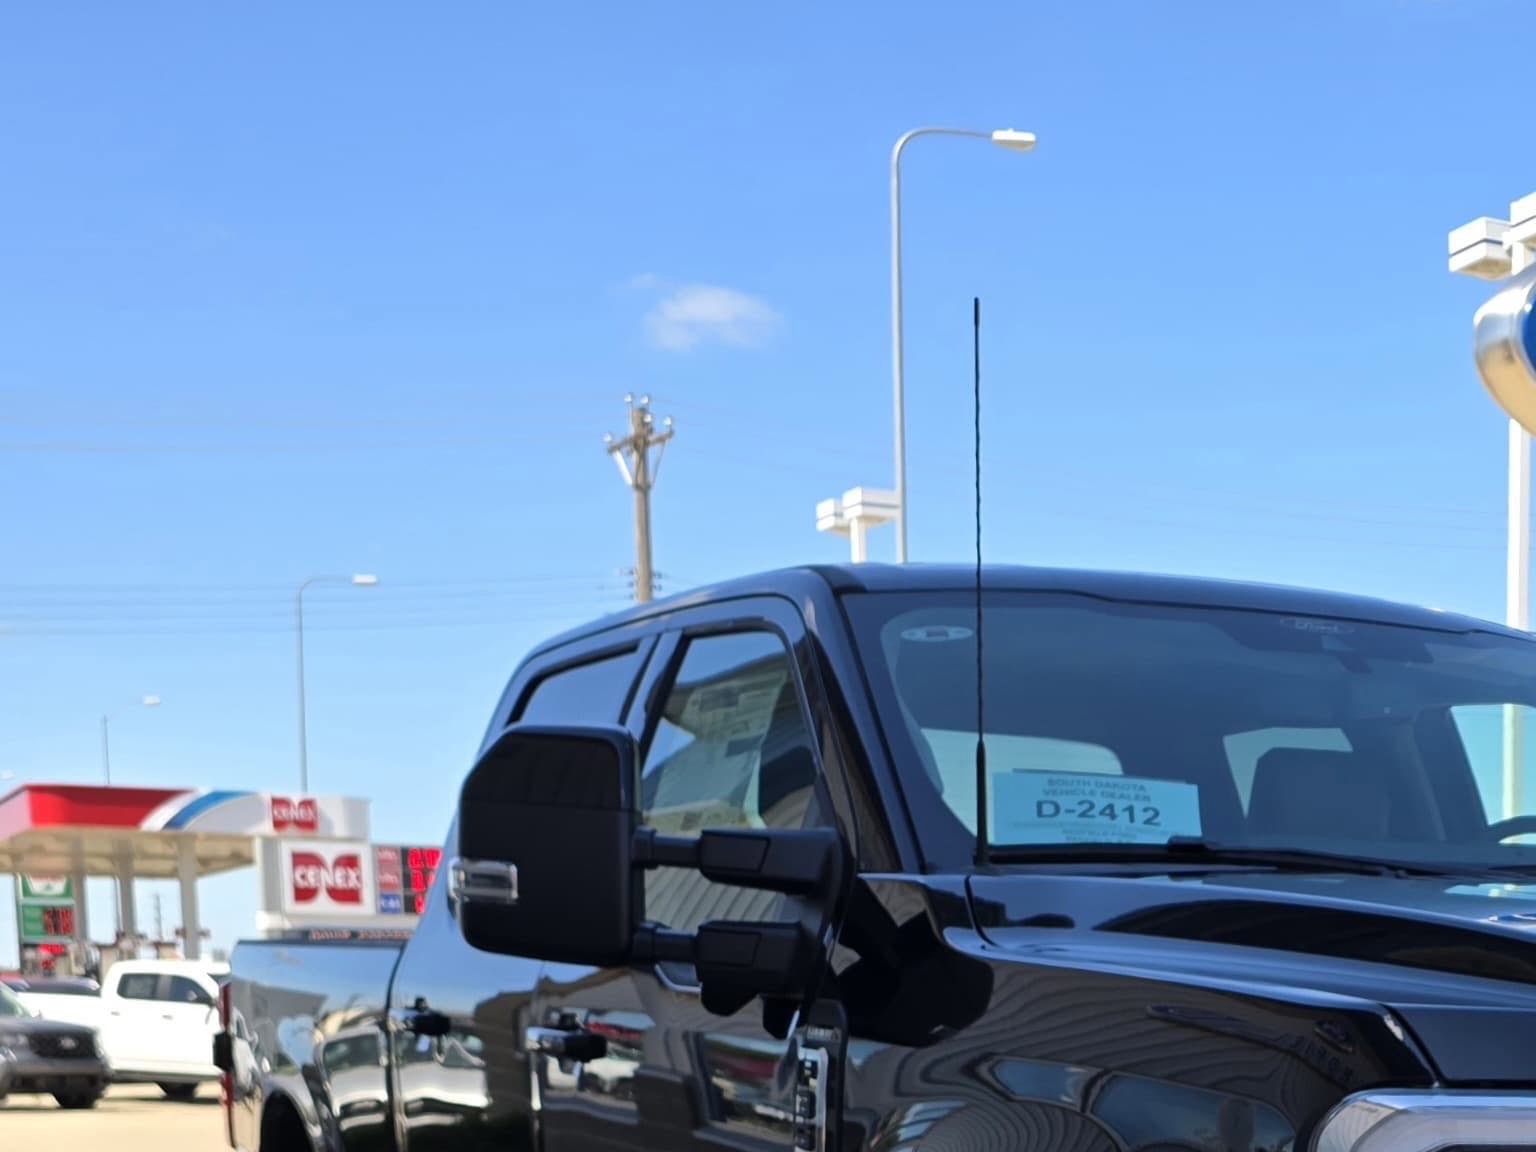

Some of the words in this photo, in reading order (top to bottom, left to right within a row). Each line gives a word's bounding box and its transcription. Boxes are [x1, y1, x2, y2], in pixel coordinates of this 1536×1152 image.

[272, 805, 315, 821] CENEX
[1035, 799, 1162, 827] D-2412
[294, 864, 362, 889] CENEX
